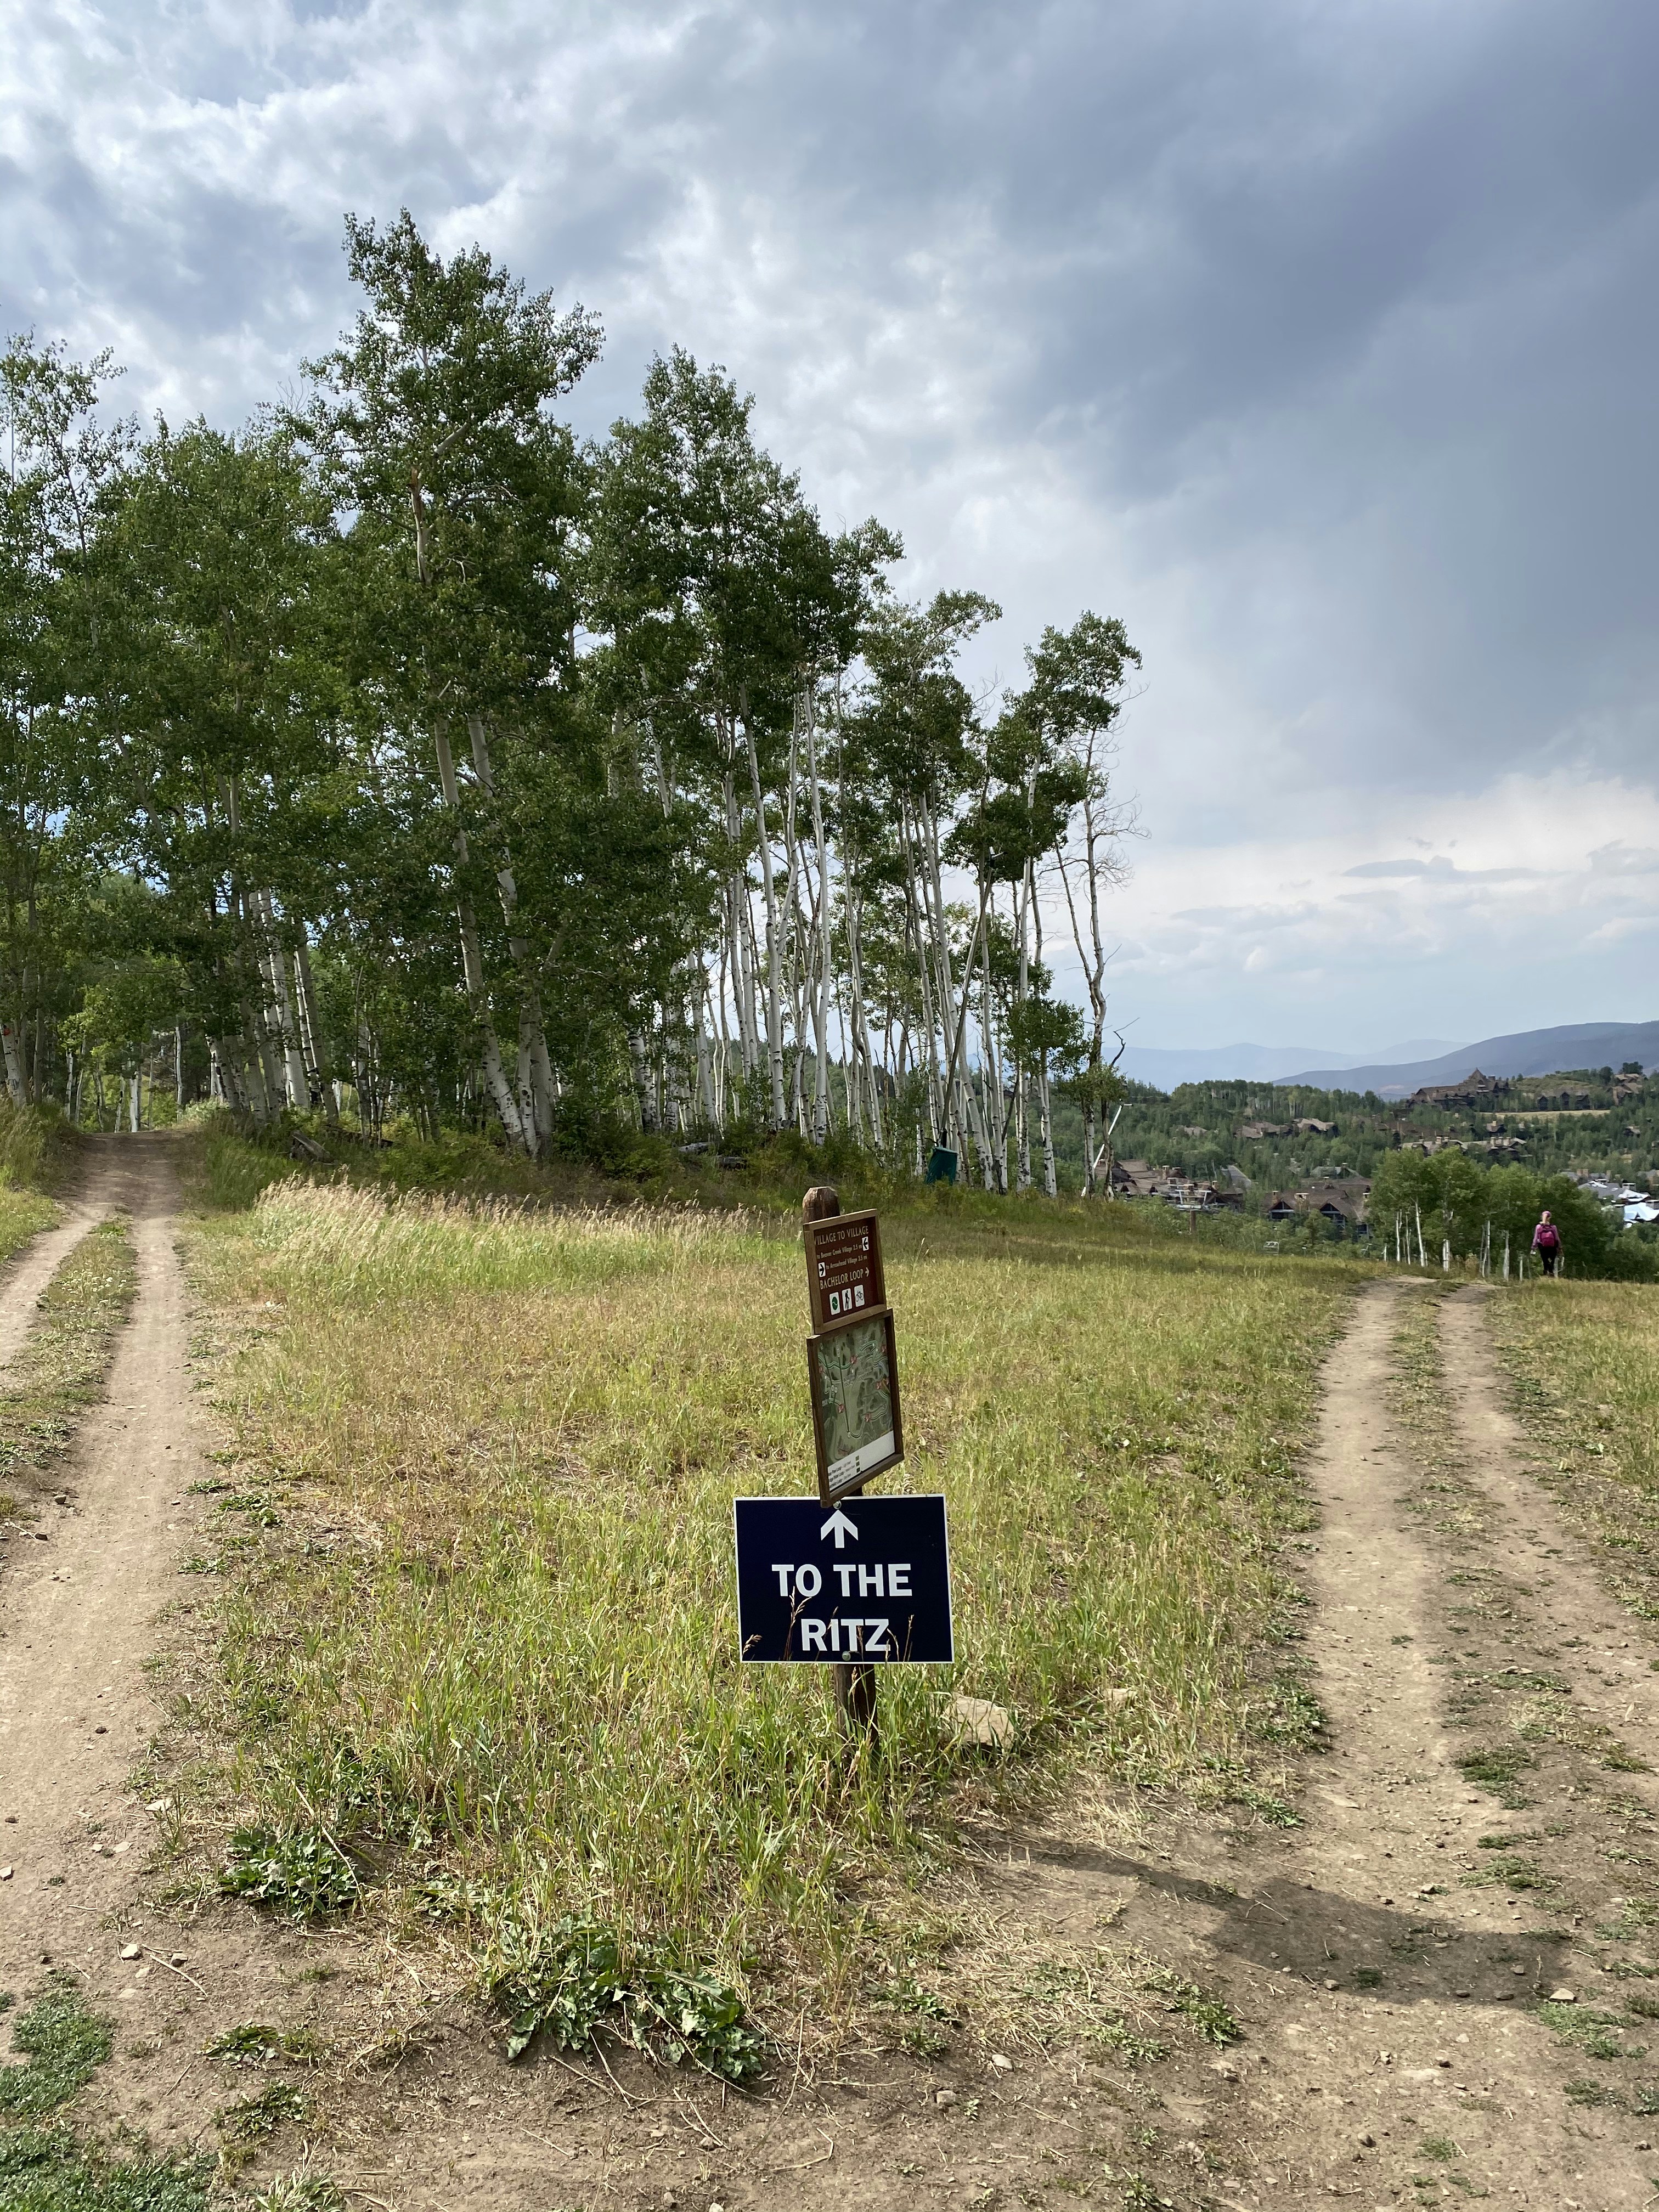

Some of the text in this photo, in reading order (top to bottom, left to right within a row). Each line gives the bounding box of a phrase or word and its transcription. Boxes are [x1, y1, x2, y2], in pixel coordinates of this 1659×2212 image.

[837, 1231, 845, 1240] TO
[847, 1226, 869, 1238] VILLAGE
[820, 1268, 864, 1290] BACHELOR LOOP
[771, 1563, 912, 1597] TO THE
[801, 1618, 891, 1651] RITZ
